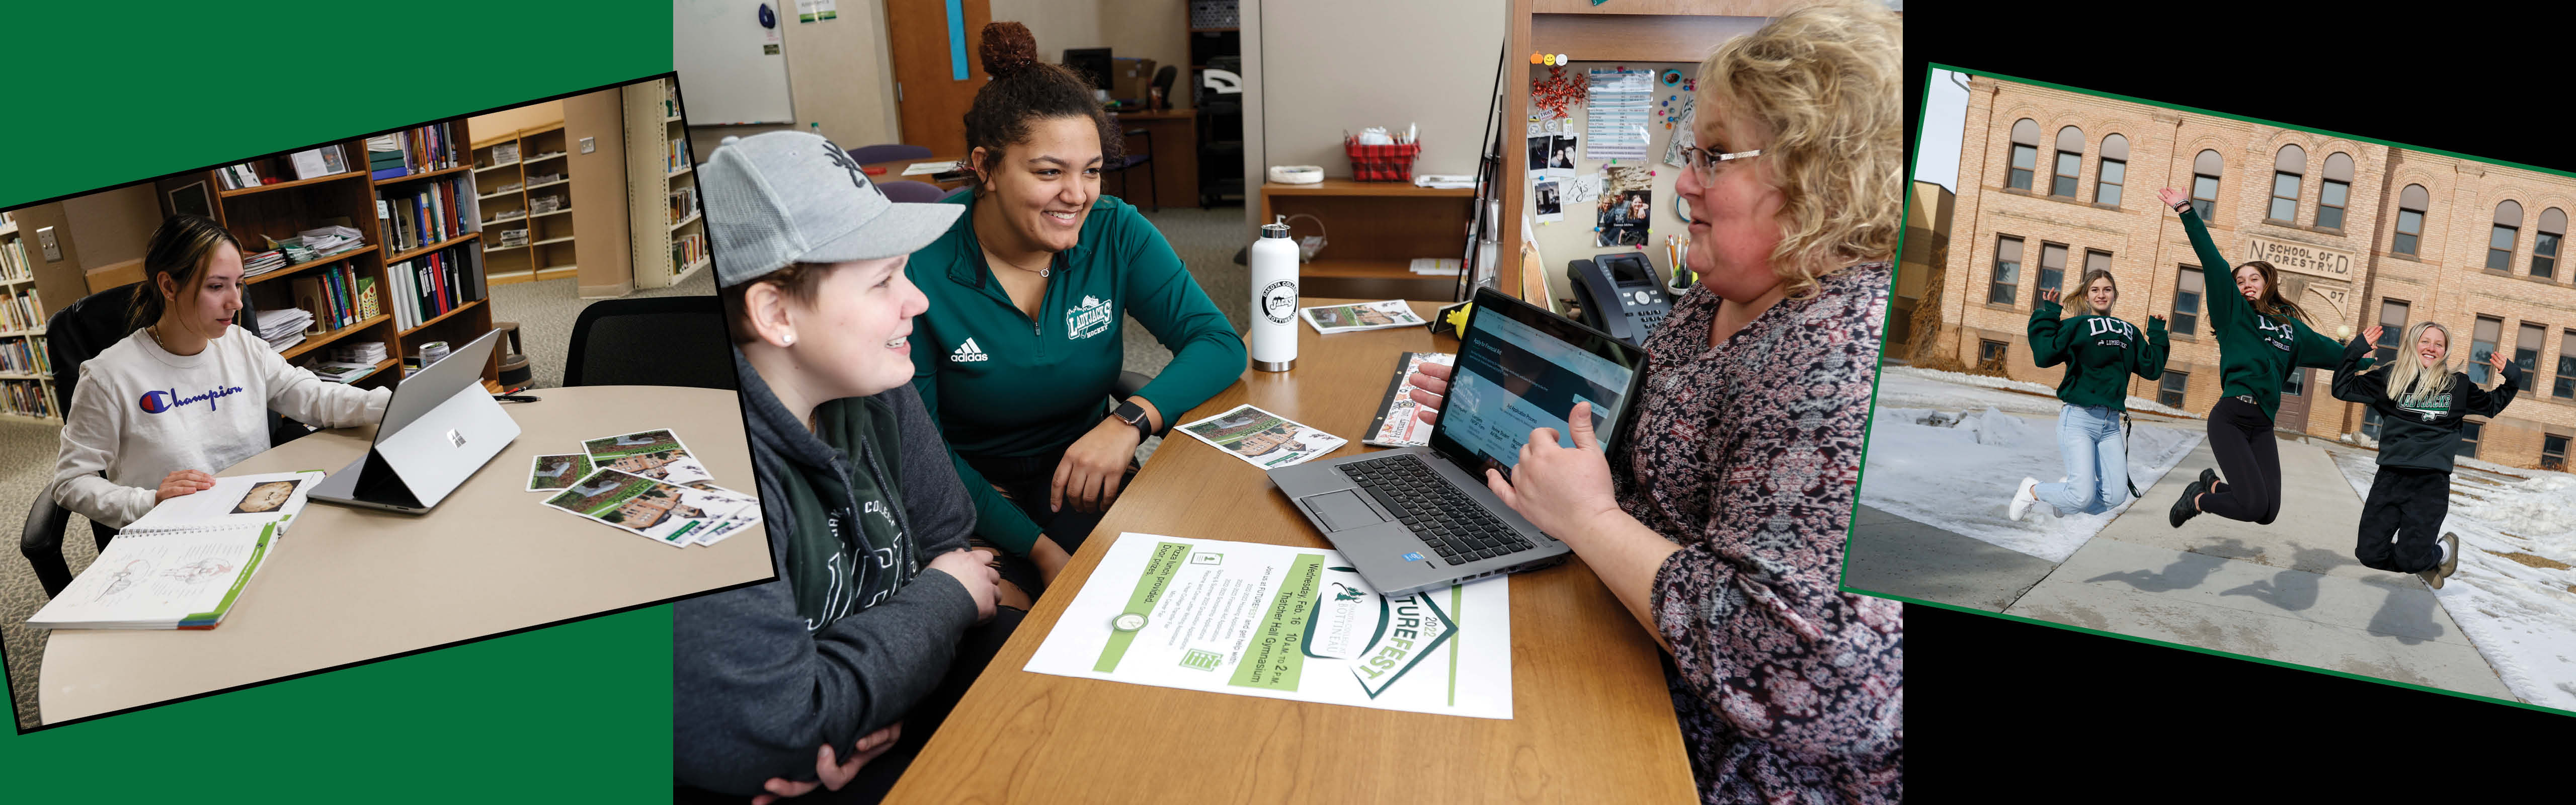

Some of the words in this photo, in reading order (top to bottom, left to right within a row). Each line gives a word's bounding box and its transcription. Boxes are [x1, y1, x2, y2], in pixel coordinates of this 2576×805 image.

[2269, 244, 2312, 259] SCHOOL
[2319, 252, 2333, 262] OF
[1263, 282, 1281, 297] DAKOTA
[1069, 301, 1111, 337] LADYJACKS
[1087, 324, 1108, 339] HOCKEY
[2087, 317, 2133, 342] DCB
[1485, 341, 1497, 353] Financial
[950, 352, 989, 362] adidas
[139, 385, 243, 414] Champion
[2398, 394, 2451, 408] LADYJACKS
[1390, 418, 1408, 439] February
[1158, 544, 1171, 558] Door
[1170, 545, 1184, 559] Pizza
[1145, 558, 1161, 576] prizes.
[1160, 560, 1176, 575] lunch
[1265, 566, 1273, 575] Join
[1297, 564, 1318, 598] Wednesday,
[1144, 577, 1164, 603] provided.
[1248, 587, 1265, 618] FUTUREFEST
[1274, 592, 1292, 620] Thatcher
[1294, 601, 1307, 614] Feb.
[1242, 619, 1251, 629] and
[1267, 622, 1281, 635] Hall
[1326, 602, 1346, 653] BOTTINEAU
[1423, 616, 1437, 636] 2022
[1239, 629, 1247, 638] get
[1284, 633, 1297, 641] 10
[1233, 639, 1244, 650] help
[1228, 652, 1237, 664] with:
[1251, 637, 1275, 682] Gymnasium
